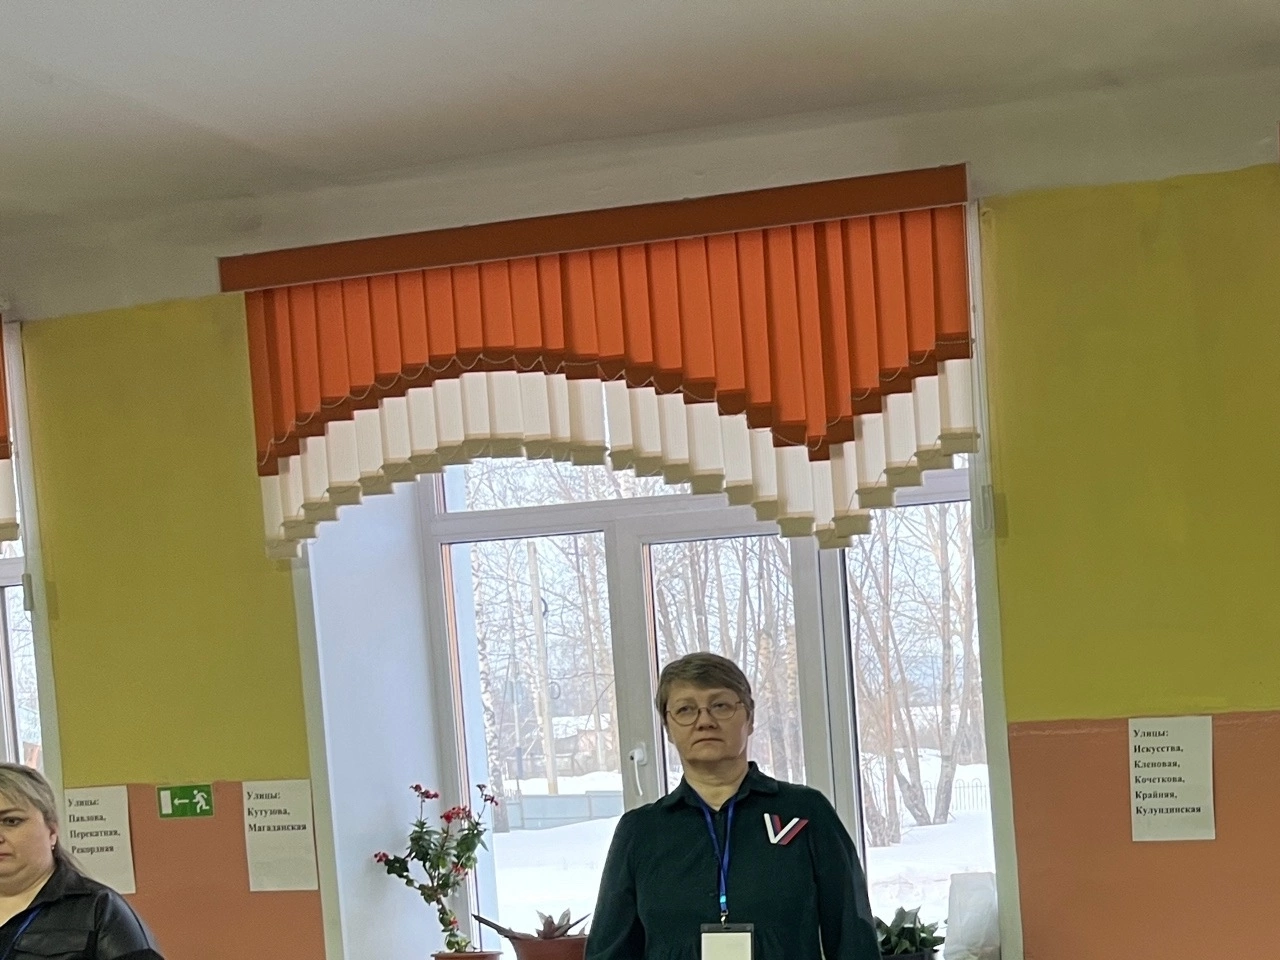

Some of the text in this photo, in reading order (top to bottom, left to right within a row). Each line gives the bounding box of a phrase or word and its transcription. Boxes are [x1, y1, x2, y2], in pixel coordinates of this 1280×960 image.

[1133, 729, 1170, 738] Улицы:
[1133, 745, 1184, 754] Искусства,
[1134, 760, 1182, 769] Кленовая,
[1134, 775, 1186, 784] Кочеткова,
[246, 791, 281, 800] Улицы:
[1135, 791, 1178, 800] Крайняя,
[247, 807, 290, 818] Кутузова,
[1136, 806, 1201, 816] Кулундинская
[248, 823, 307, 832] Магаданская
